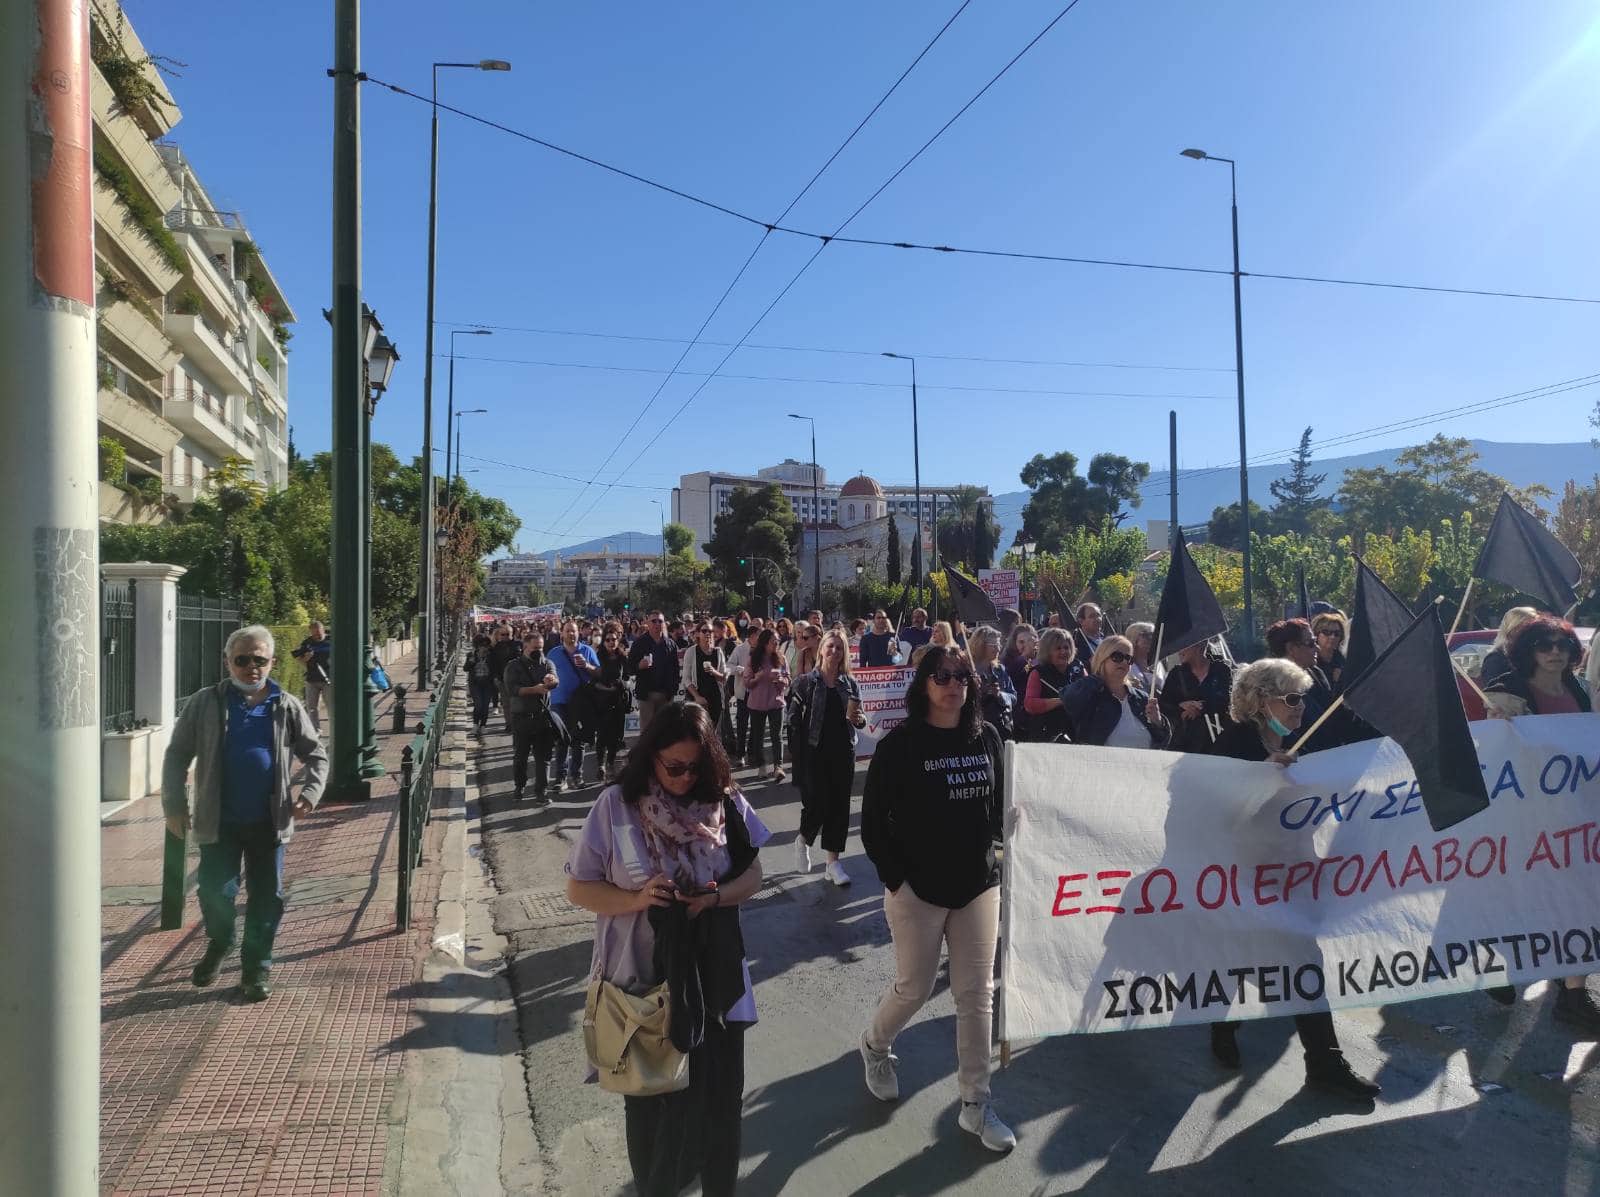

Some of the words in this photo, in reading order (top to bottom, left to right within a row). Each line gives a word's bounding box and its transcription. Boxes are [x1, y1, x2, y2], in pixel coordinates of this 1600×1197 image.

[924, 757, 961, 772] ΘΕΛΟΥΜΕ
[946, 773, 966, 785] ΚΑΙ
[967, 770, 988, 782] ΟΧΙ
[949, 785, 990, 800] ΑΝΕΡΓΙΑ
[1279, 789, 1366, 831] ΟΧΙ
[1051, 868, 1185, 917] ΕΞΩ
[1196, 863, 1242, 910] ΟΙ
[1253, 835, 1508, 906] ΕΡΓΟΛΑΒΟΙ
[1102, 962, 1326, 1020] ΣΩΜΑΤΕΙΟ
